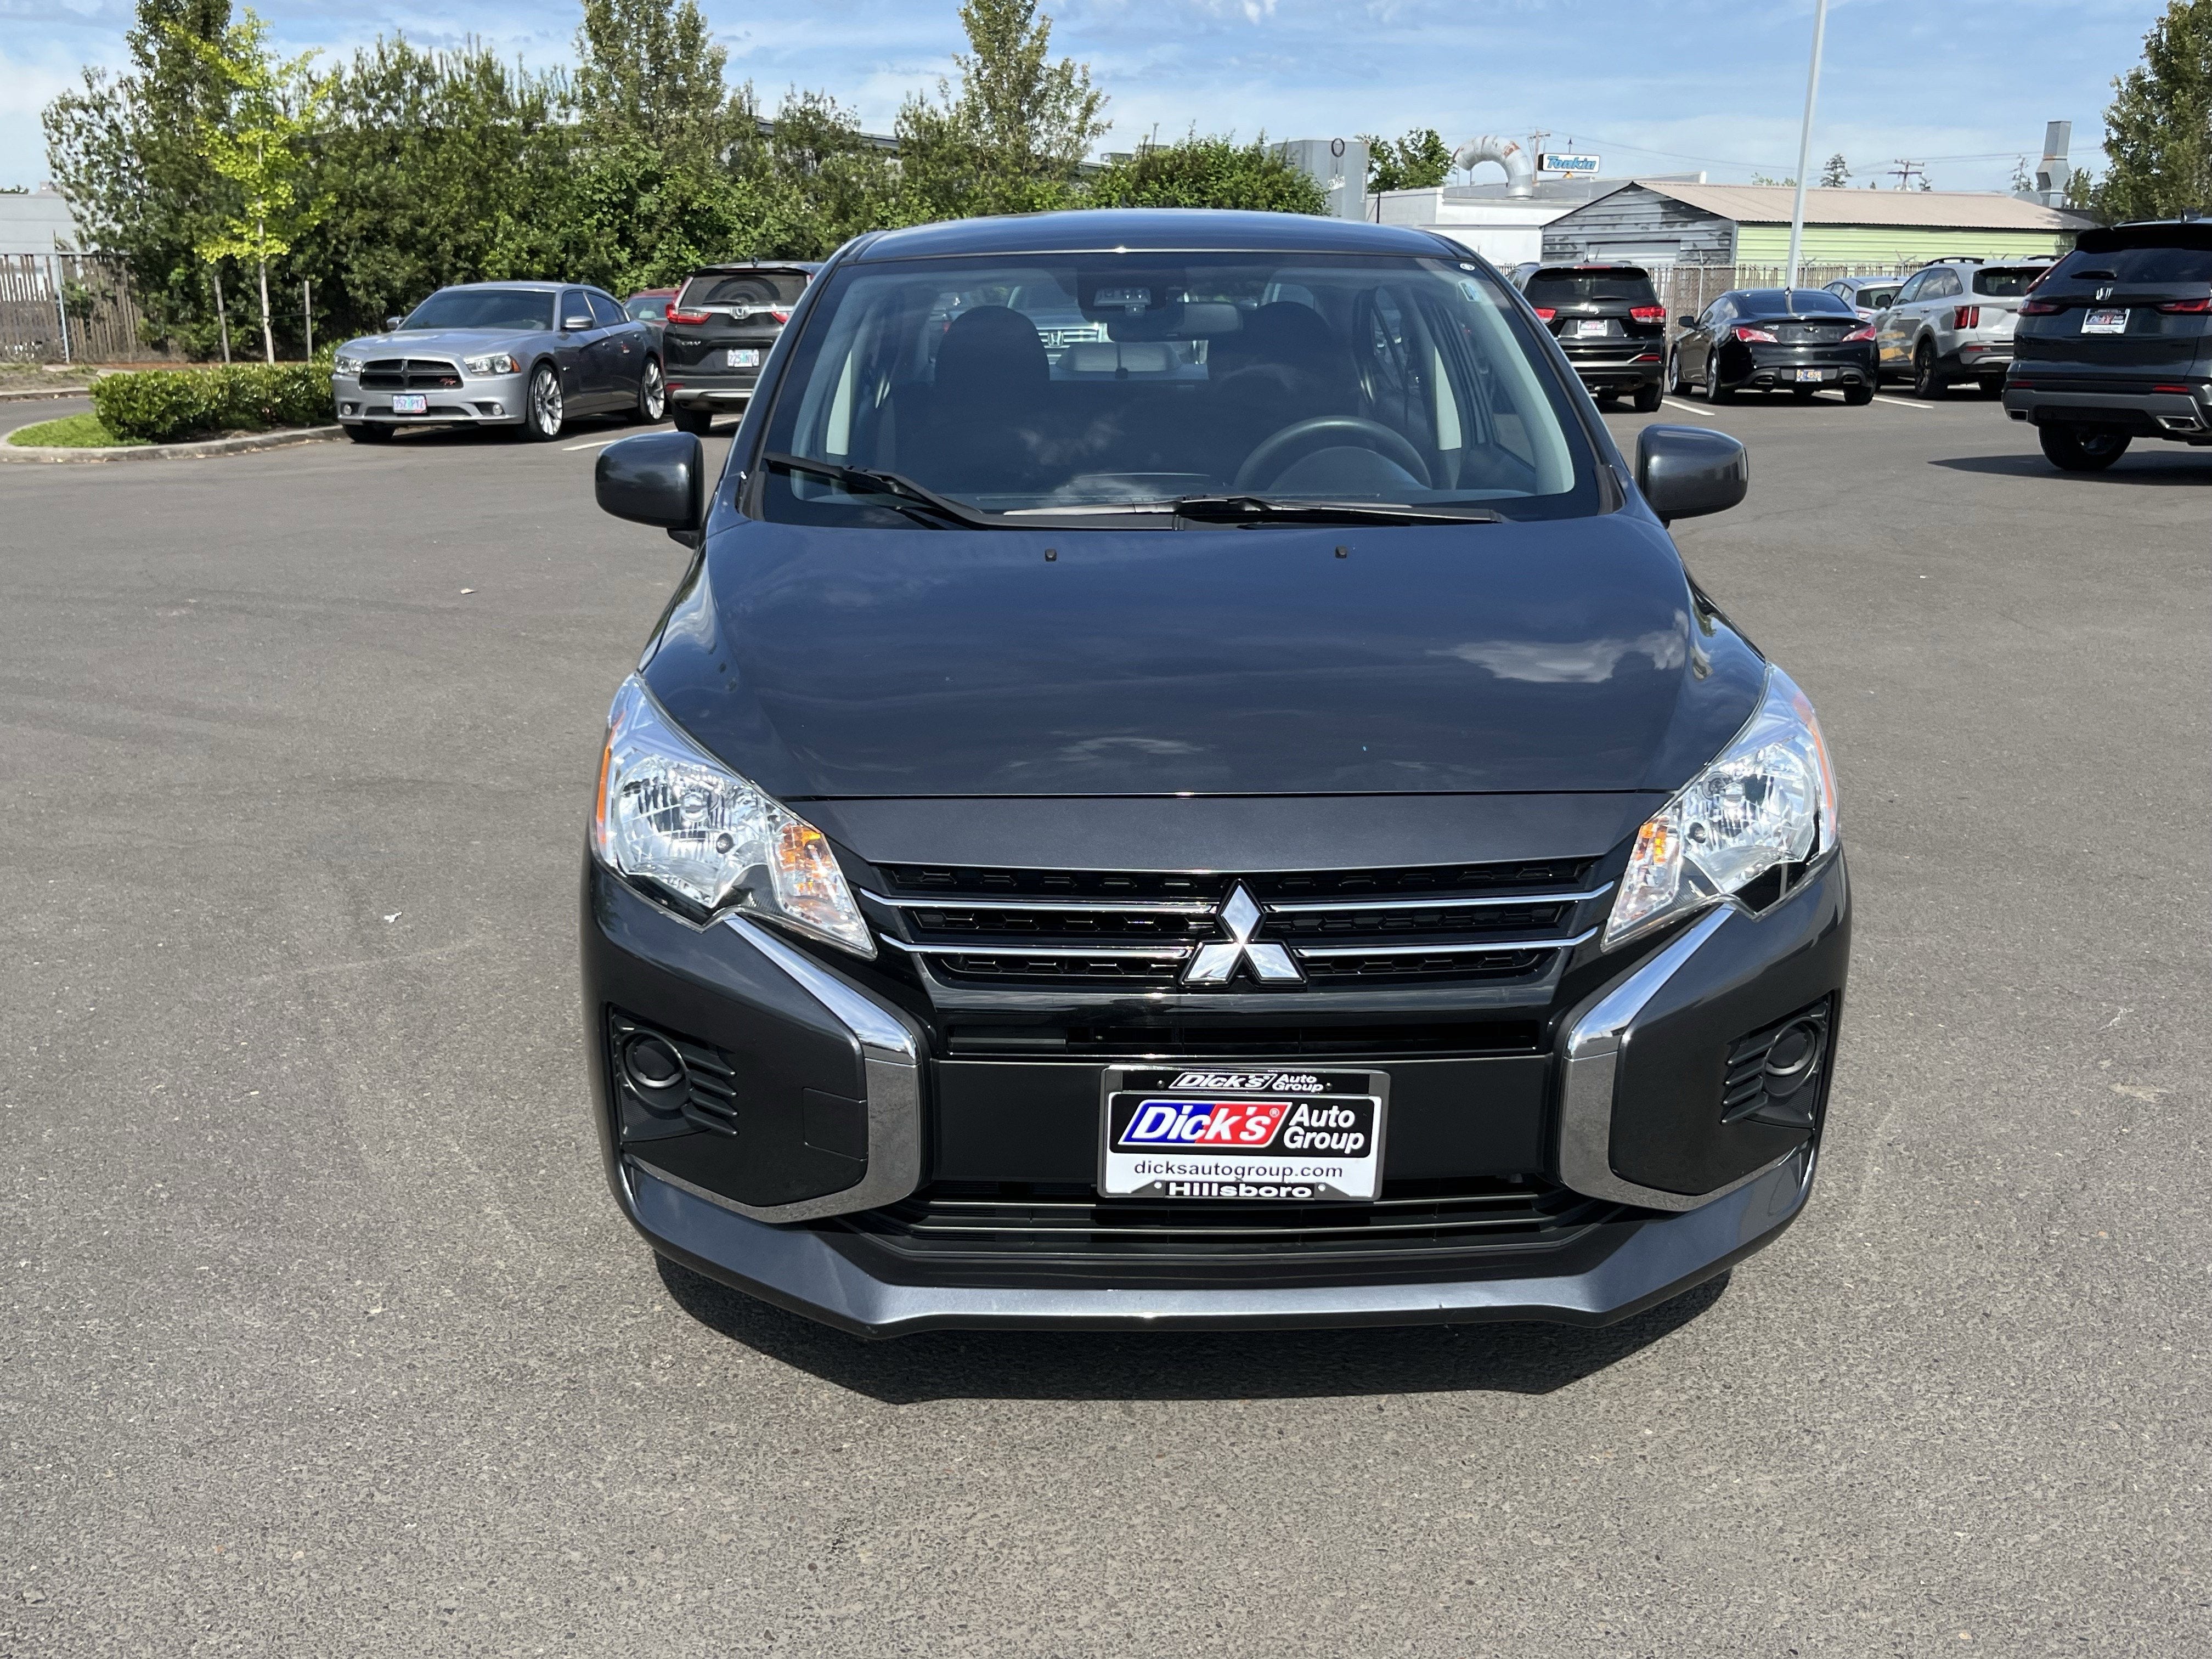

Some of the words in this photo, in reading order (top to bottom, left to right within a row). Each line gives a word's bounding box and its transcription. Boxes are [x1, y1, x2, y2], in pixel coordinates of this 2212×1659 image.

[1547, 156, 1596, 170] Tonkin
[1272, 1081, 1324, 1093] Group
[1276, 1074, 1317, 1084] Auto
[1131, 1105, 1271, 1141] Dick's
[1288, 1103, 1356, 1128] Auto
[1283, 1127, 1365, 1154] Group
[1134, 1161, 1343, 1181] dicksautogroup.com
[1168, 1181, 1313, 1198] Hillsboro
